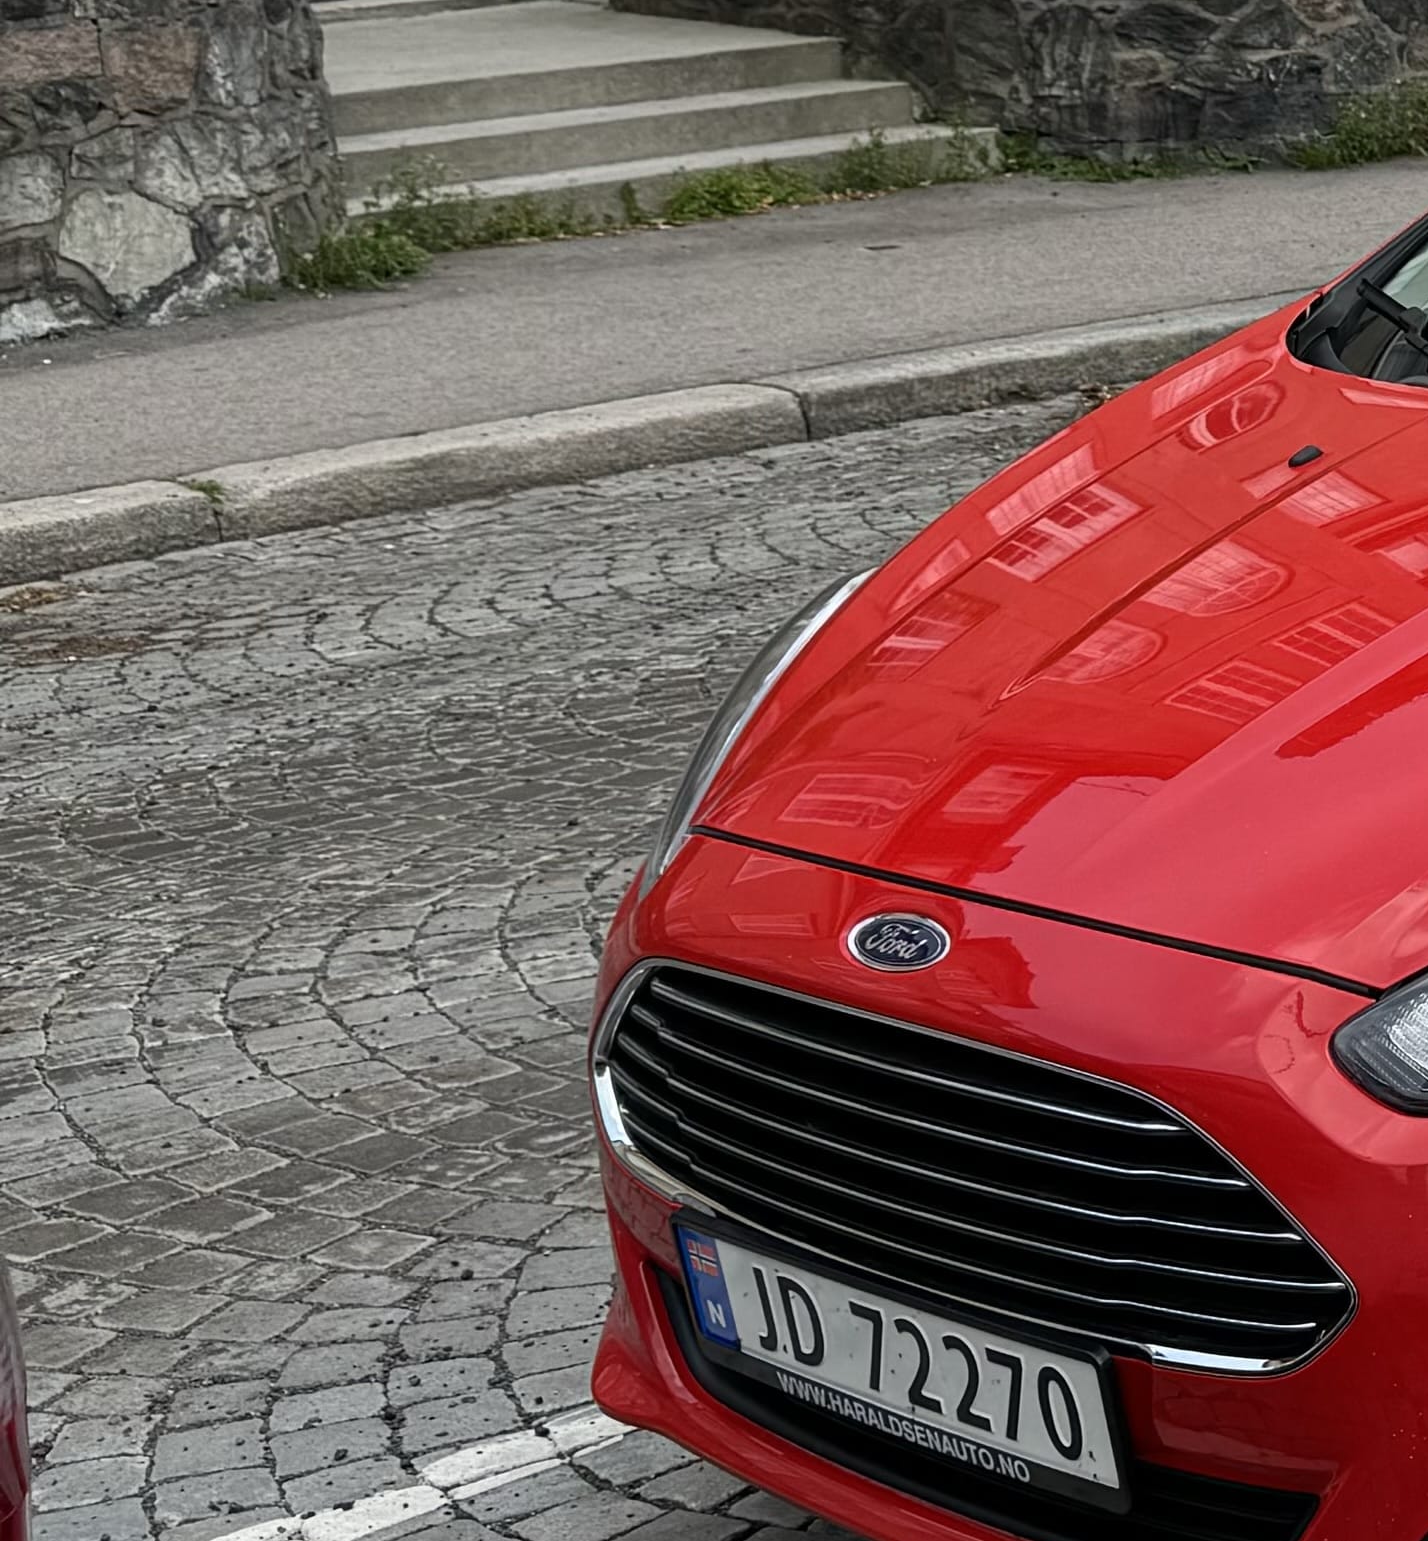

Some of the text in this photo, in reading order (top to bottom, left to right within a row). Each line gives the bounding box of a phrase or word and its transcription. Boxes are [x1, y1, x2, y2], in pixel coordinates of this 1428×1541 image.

[865, 923, 928, 959] Ford
[706, 1299, 725, 1329] N
[752, 1266, 1084, 1462] JD 72270
[776, 1370, 1031, 1484] WWW.HARALDSENAUTO.NO
